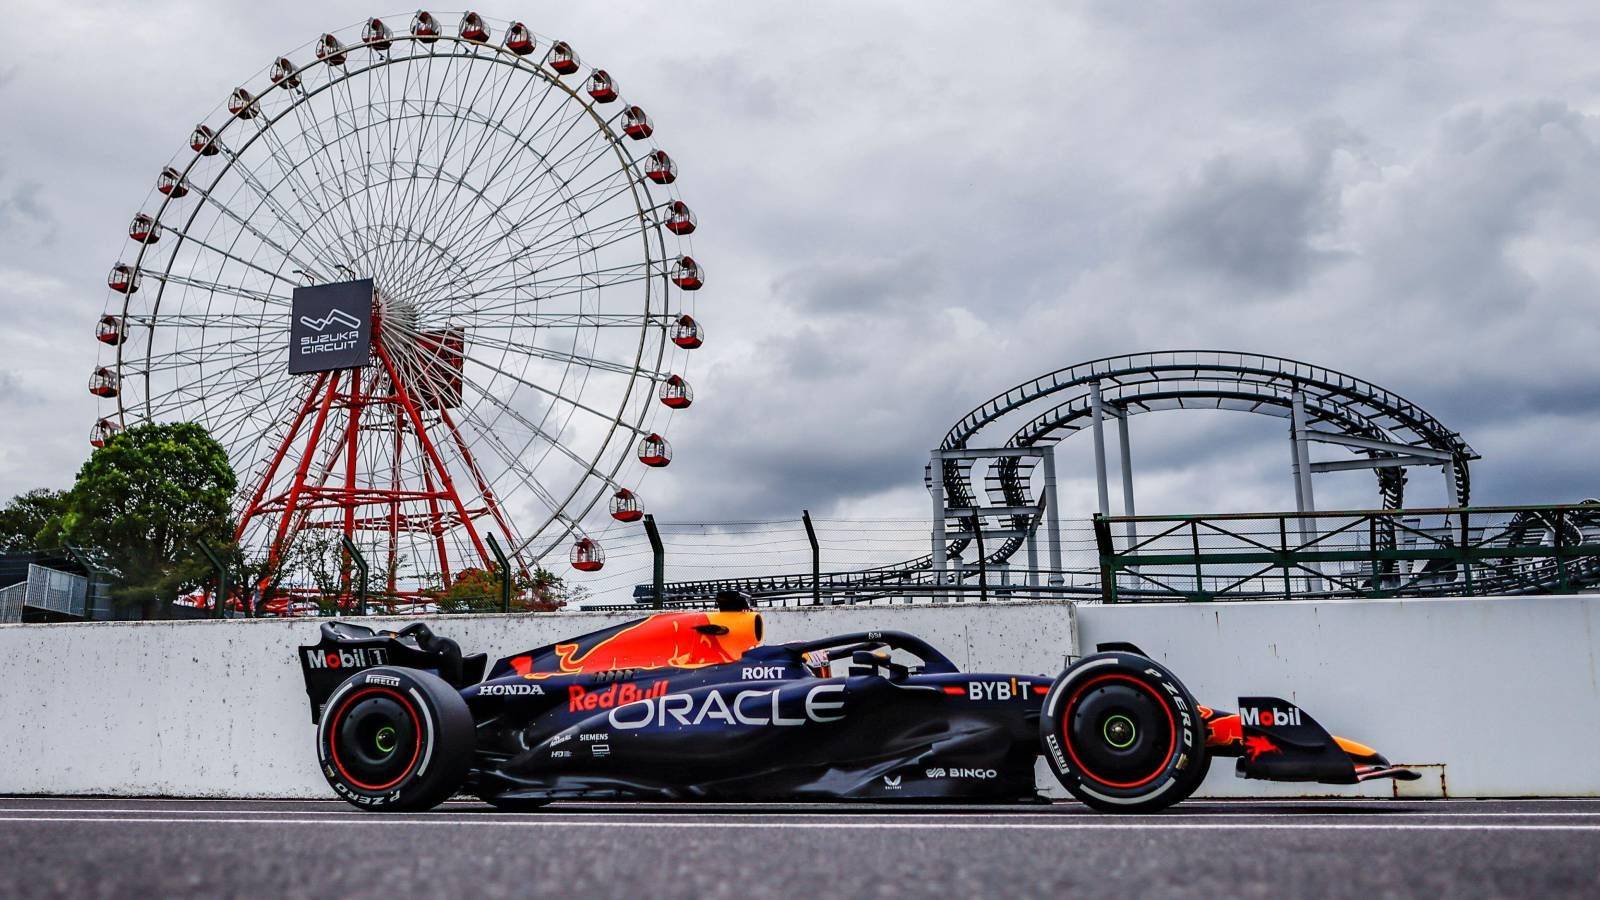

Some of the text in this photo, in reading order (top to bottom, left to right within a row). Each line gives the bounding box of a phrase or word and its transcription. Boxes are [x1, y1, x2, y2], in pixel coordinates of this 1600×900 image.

[300, 331, 359, 345] SUZUKA
[302, 340, 357, 354] CIRCUIT
[306, 648, 382, 669] Mobil 1
[365, 674, 401, 687] PIRELLI
[741, 666, 786, 680] ROKT
[477, 684, 545, 696] HONDA
[568, 682, 618, 713] Red
[969, 677, 1031, 700] BYBIT
[608, 684, 847, 730] ORACLE
[1161, 681, 1192, 748] ZERO
[1239, 707, 1302, 727] Mobil
[579, 733, 609, 742] SIEMENS
[1046, 733, 1070, 775] PIRELLI
[949, 768, 998, 779] BINGO
[335, 782, 385, 806] ZERO
